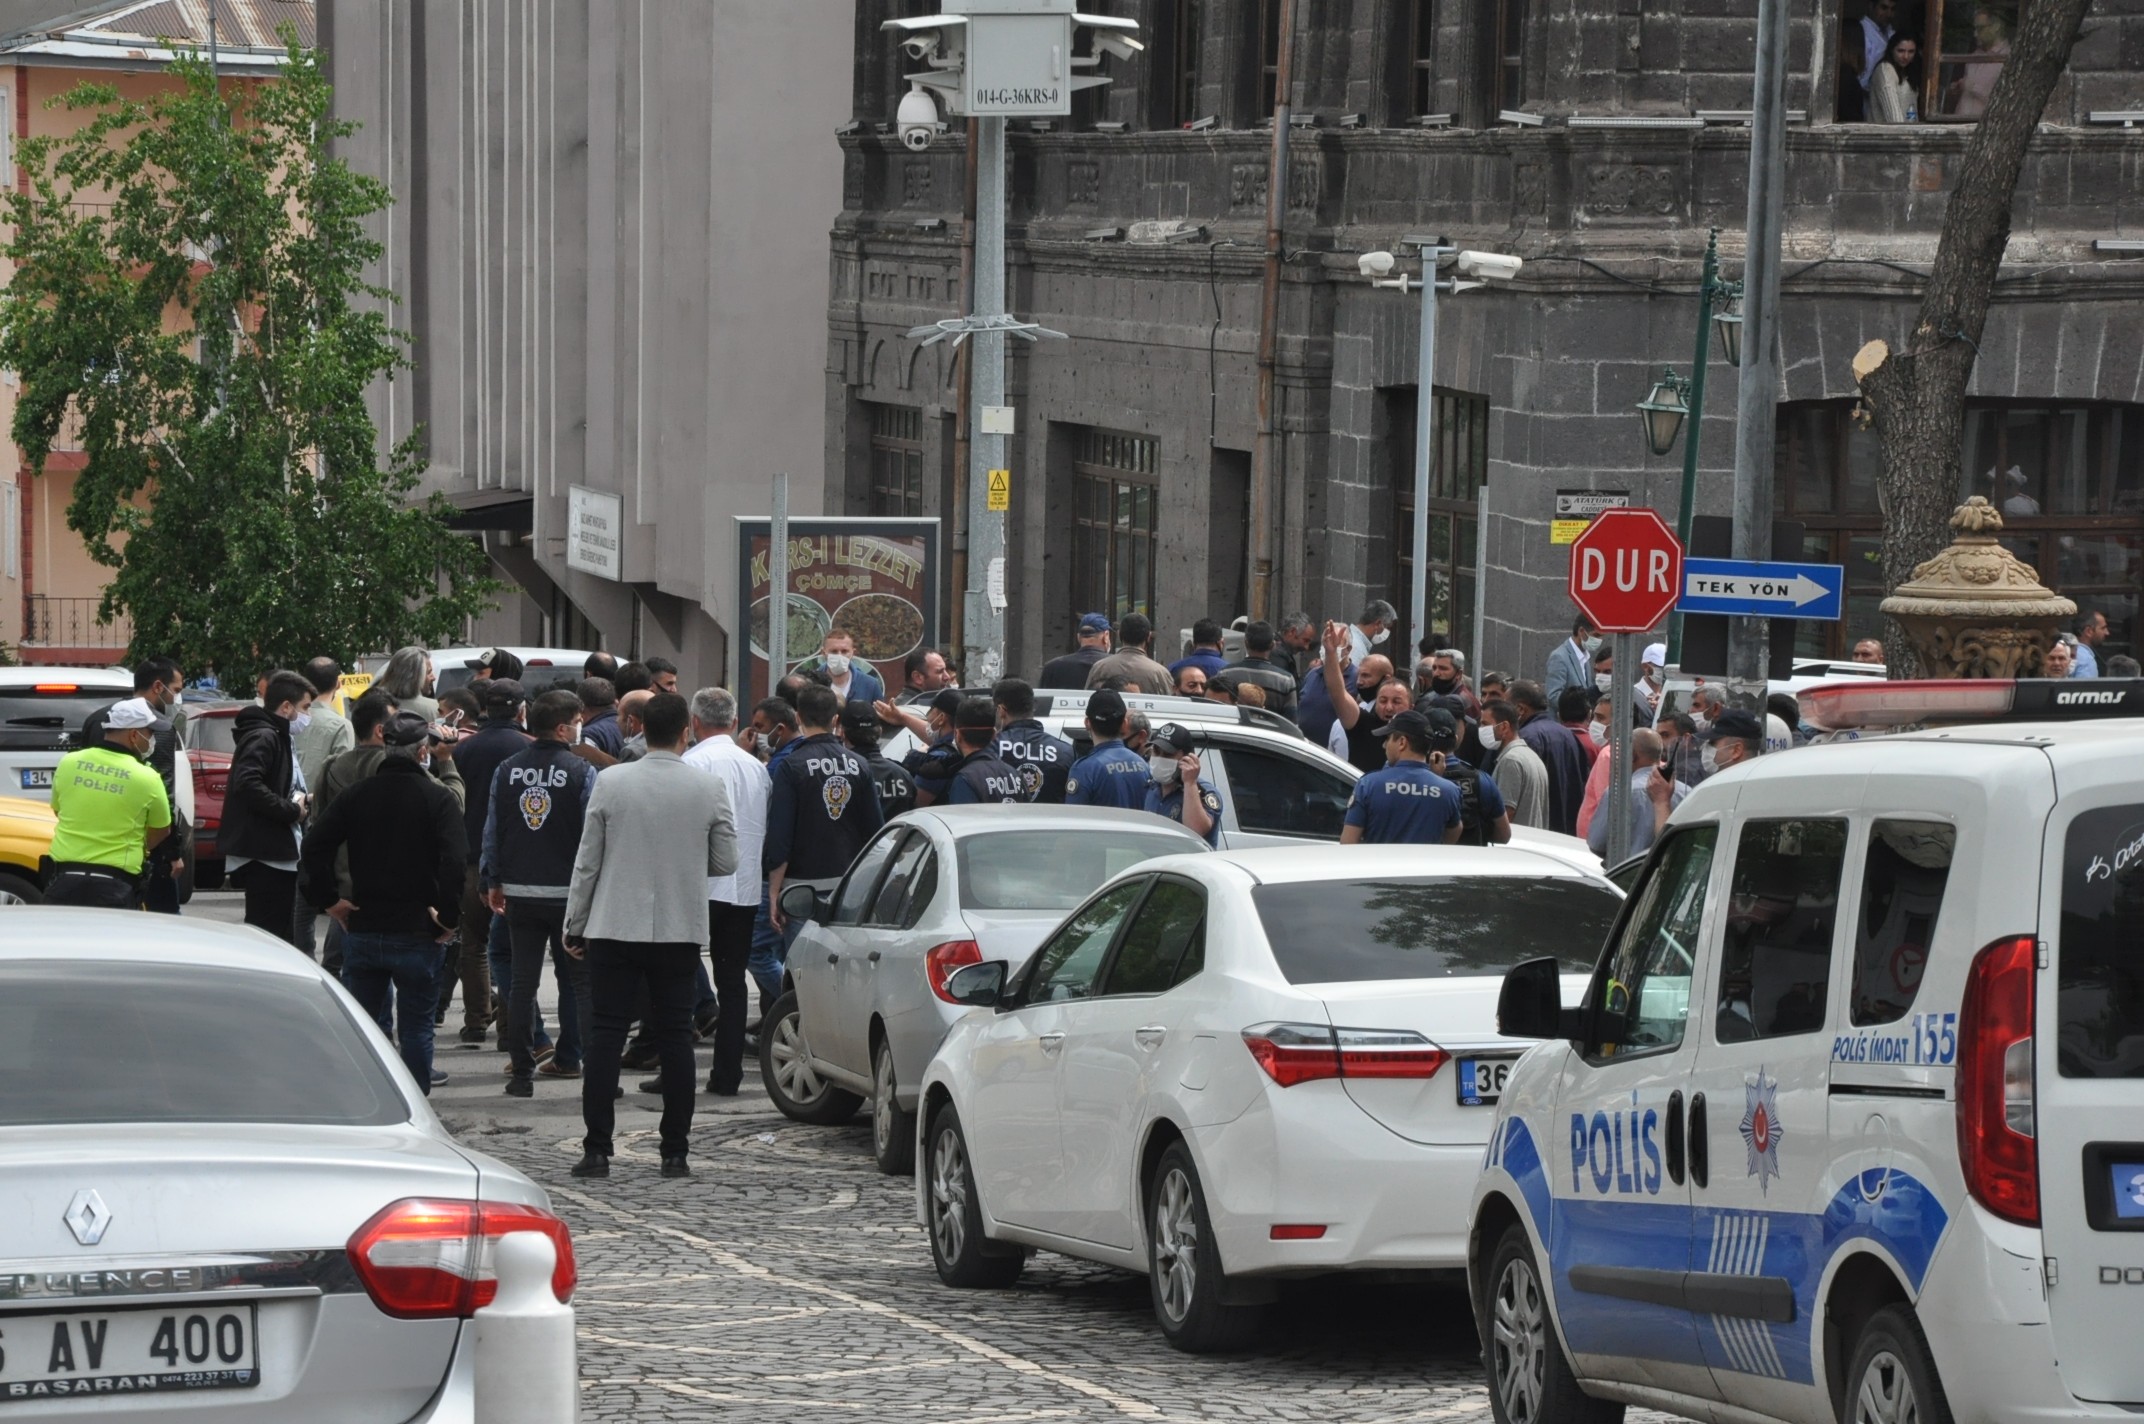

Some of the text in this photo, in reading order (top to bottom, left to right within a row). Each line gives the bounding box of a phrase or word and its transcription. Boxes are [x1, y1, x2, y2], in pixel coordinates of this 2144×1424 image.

[977, 88, 1058, 105] 014-G-36KRS-0
[751, 535, 922, 590] KRS-I LEZZET
[1581, 547, 1669, 593] DUR
[796, 572, 872, 593] ÇÖMÇE
[1697, 581, 1789, 596] TEK YÖN
[1060, 700, 1155, 710] DUER
[2057, 691, 2127, 705] armas
[31, 772, 48, 784] 34
[1832, 1012, 1956, 1065] POLİS İMDAT 155
[1463, 1081, 1475, 1090] TR
[1476, 1064, 1508, 1093] 36
[1571, 1088, 1662, 1196] POLİS
[48, 1319, 108, 1374] AV
[150, 1313, 244, 1367] 400
[184, 1372, 203, 1382] 223
[206, 1371, 219, 1380] 37
[221, 1370, 234, 1380] 37
